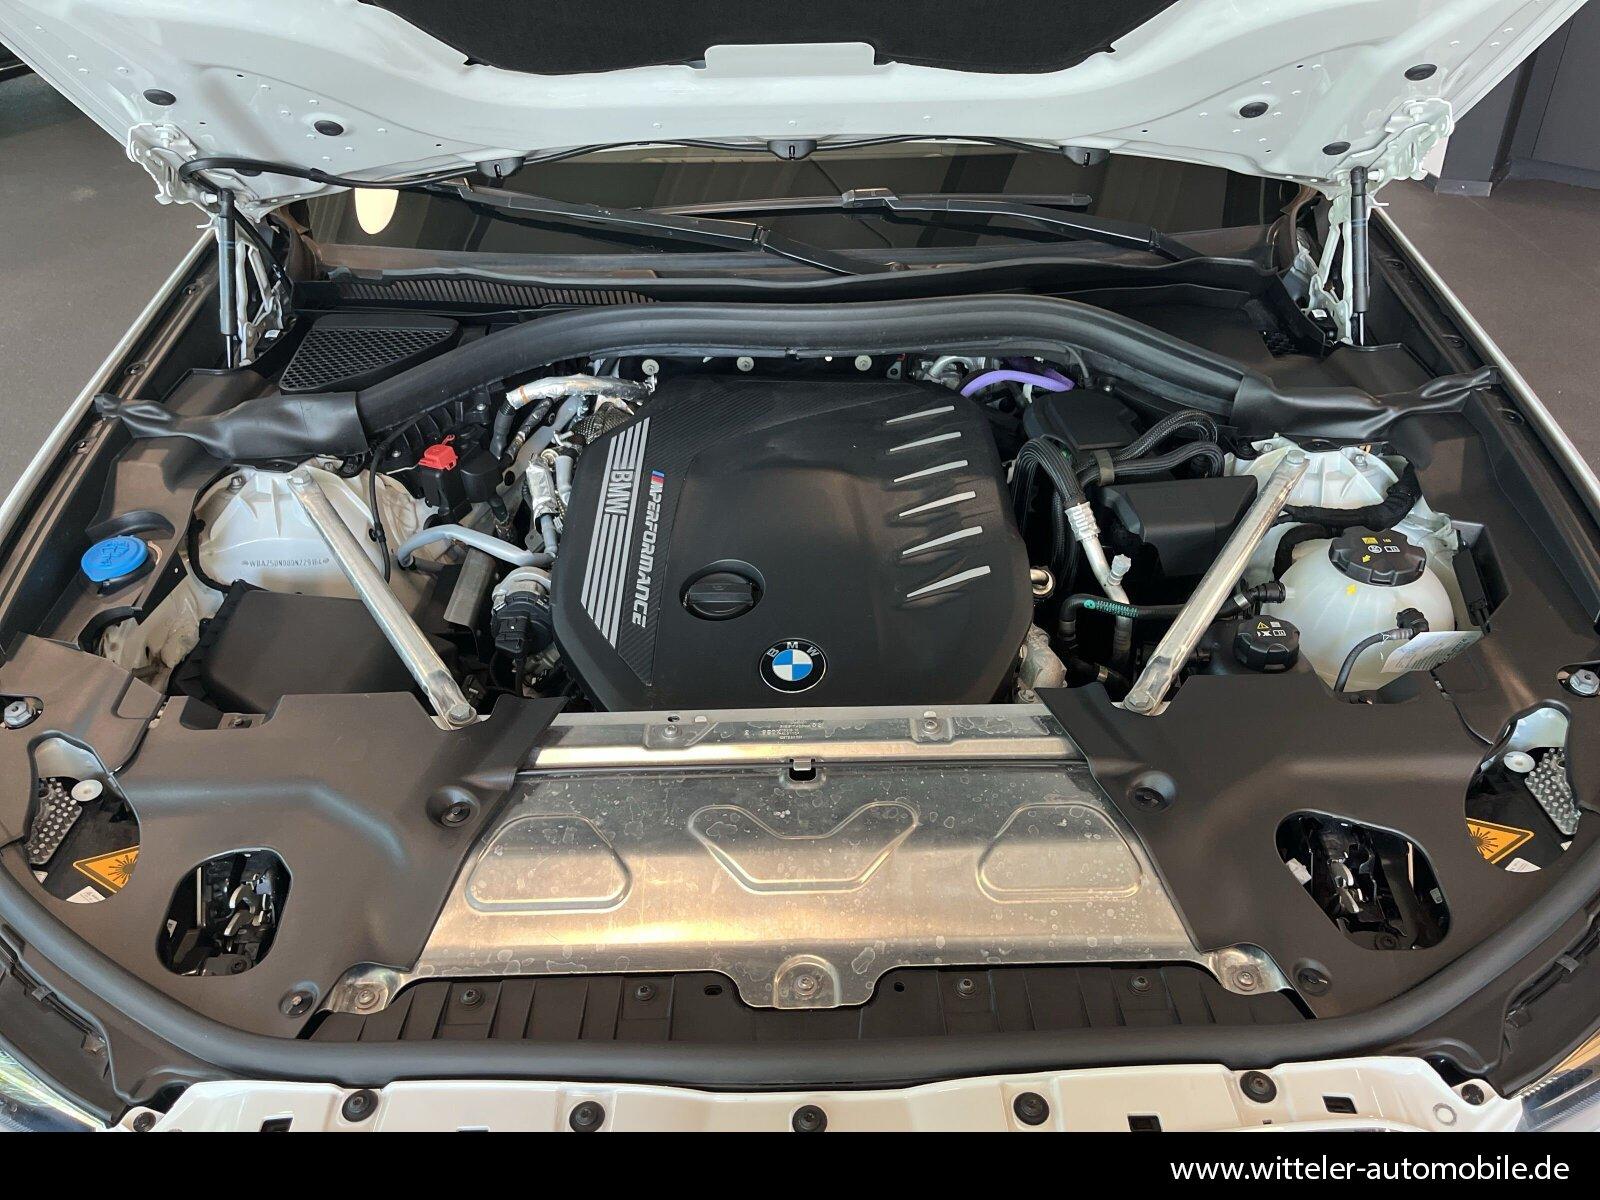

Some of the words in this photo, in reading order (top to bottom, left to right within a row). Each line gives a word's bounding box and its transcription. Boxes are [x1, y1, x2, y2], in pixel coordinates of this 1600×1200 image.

[605, 470, 634, 516] BMW
[632, 490, 662, 628] PERFORMANCE
[766, 641, 820, 658] BMW
